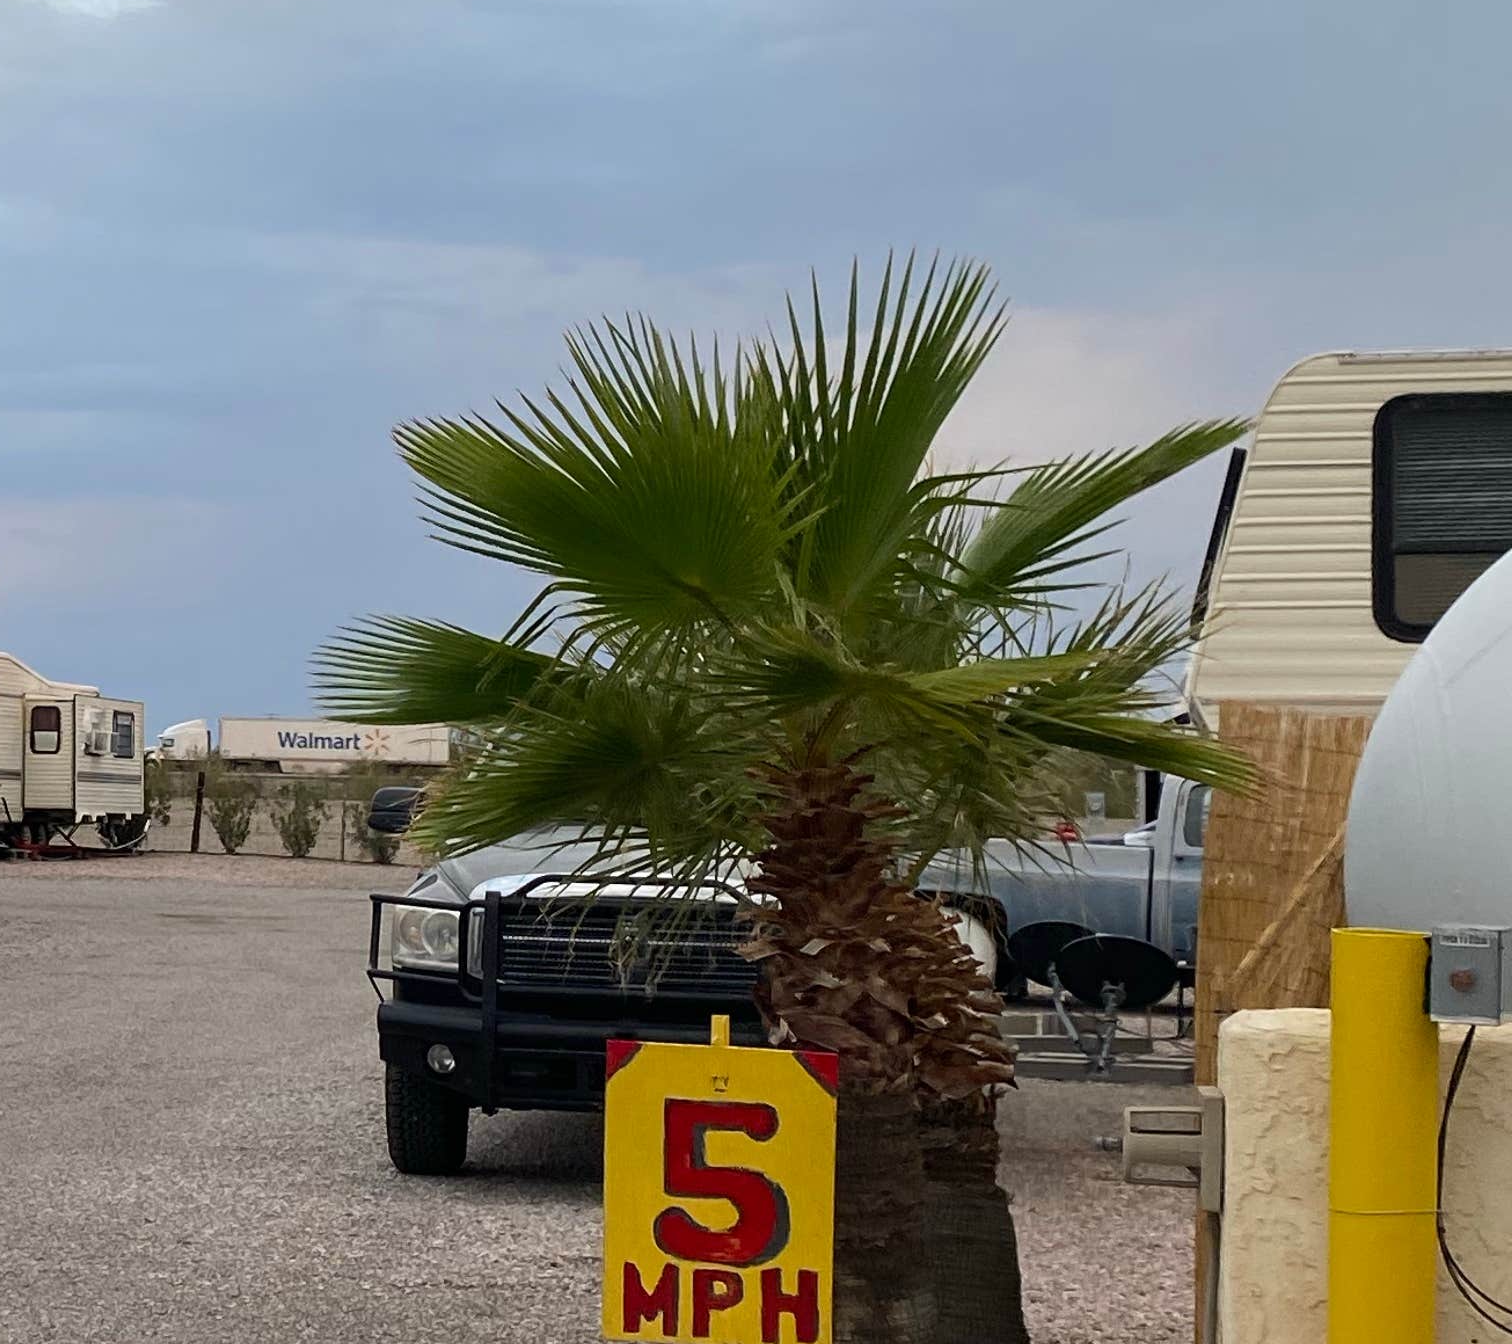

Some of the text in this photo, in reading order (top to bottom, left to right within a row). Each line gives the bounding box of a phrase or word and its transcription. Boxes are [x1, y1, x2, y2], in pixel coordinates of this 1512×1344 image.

[277, 731, 361, 750] Walmart
[653, 1097, 791, 1269] 5
[623, 1261, 820, 1344] MPH
